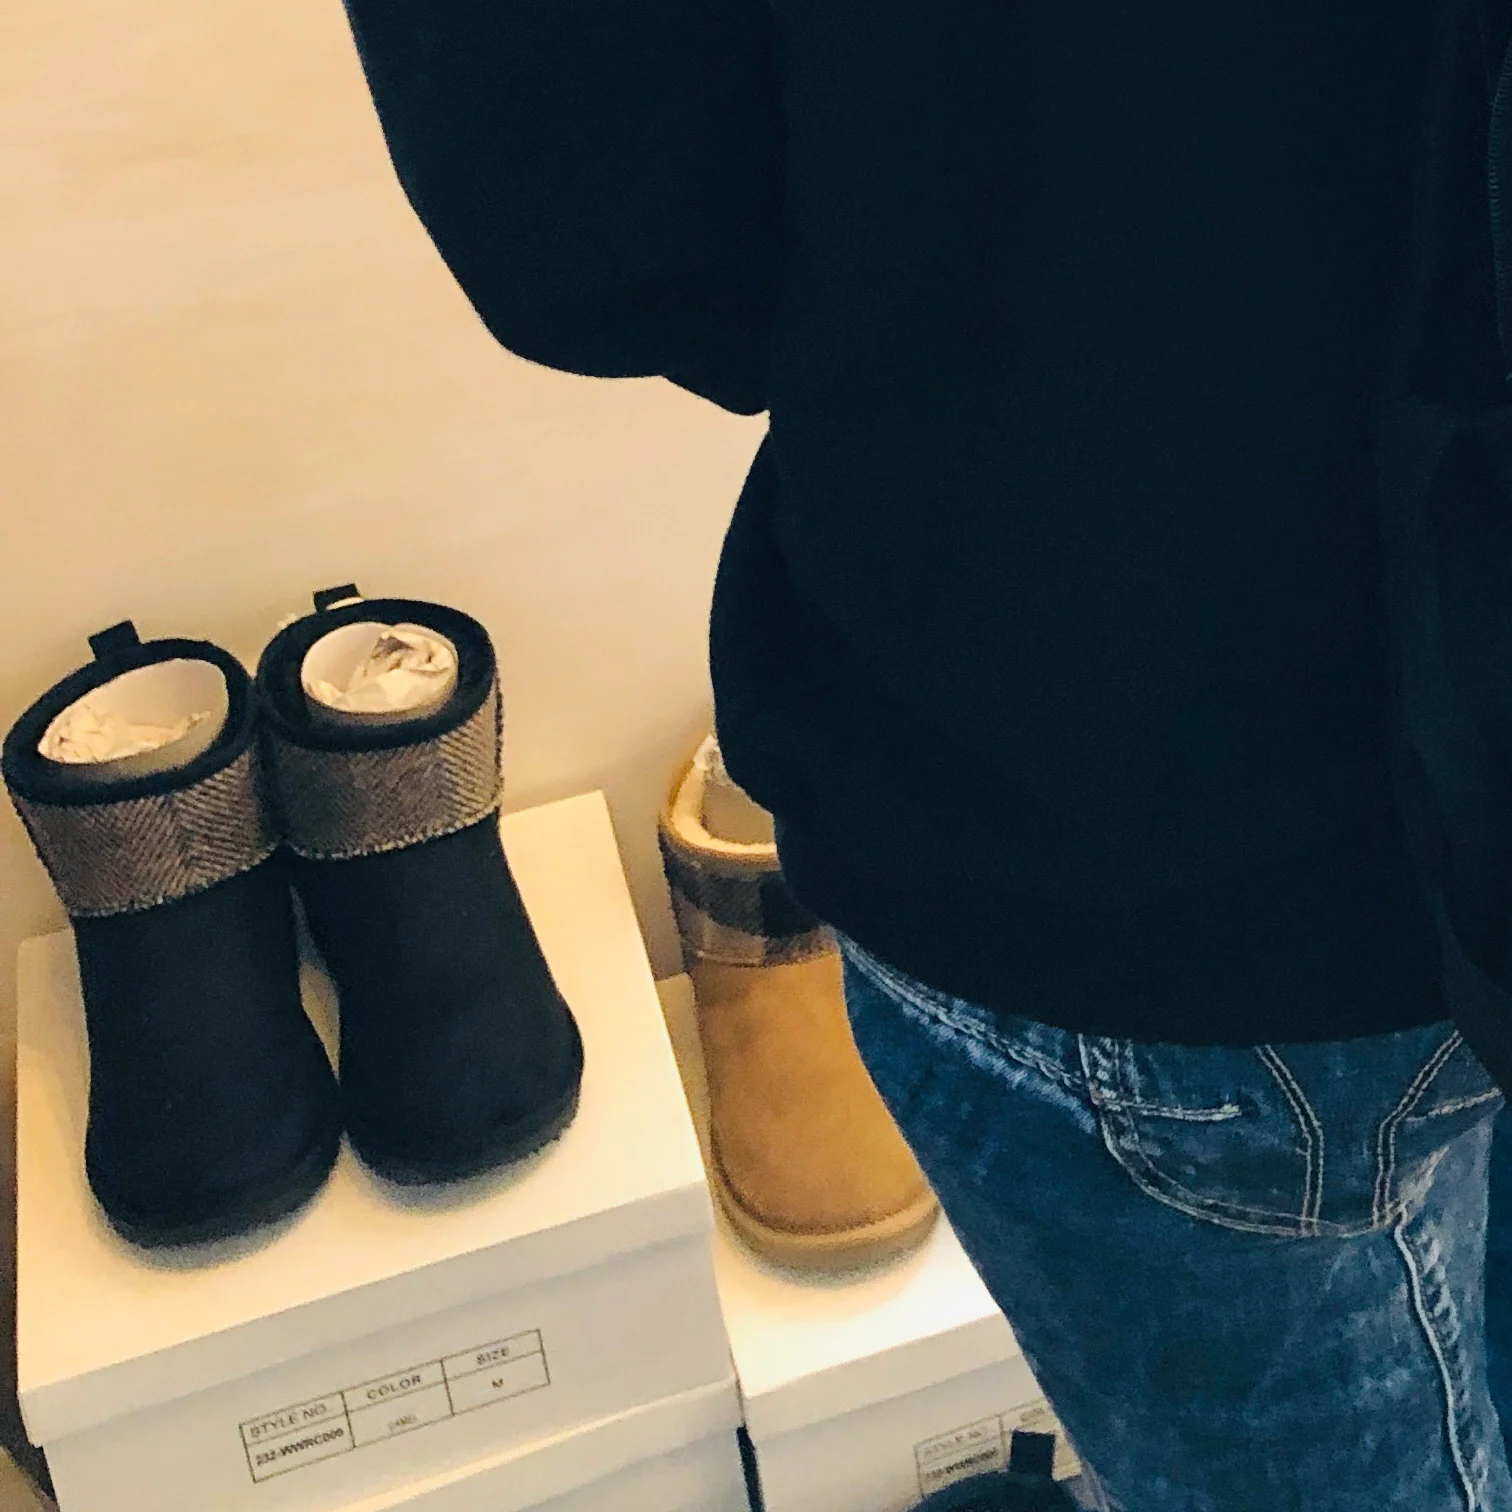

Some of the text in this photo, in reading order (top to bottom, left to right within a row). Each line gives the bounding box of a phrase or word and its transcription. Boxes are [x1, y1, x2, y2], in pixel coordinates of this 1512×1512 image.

[476, 1346, 510, 1366] SIZE
[366, 1374, 422, 1400] COLOR
[250, 1414, 297, 1437] STYLE
